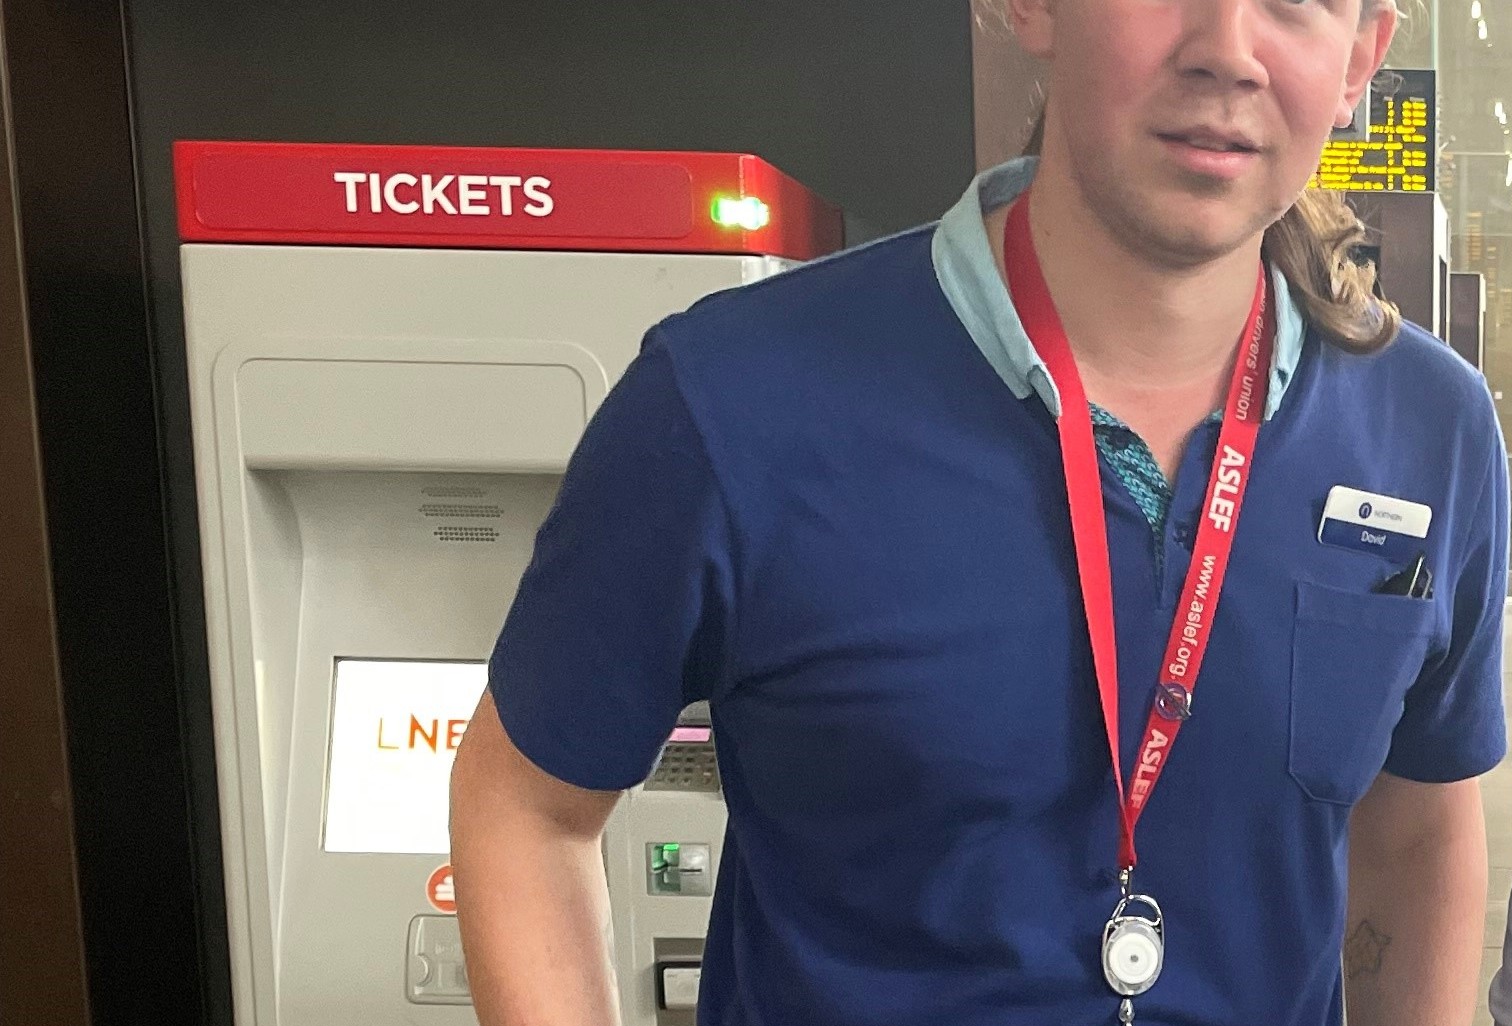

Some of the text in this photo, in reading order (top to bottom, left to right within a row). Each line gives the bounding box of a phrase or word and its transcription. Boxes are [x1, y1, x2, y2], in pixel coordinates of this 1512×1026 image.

[334, 171, 555, 218] TICKETS
[1236, 376, 1254, 421] union
[1208, 444, 1246, 533] ASLEF
[1361, 530, 1387, 545] David
[1130, 728, 1169, 809] ASLEF
